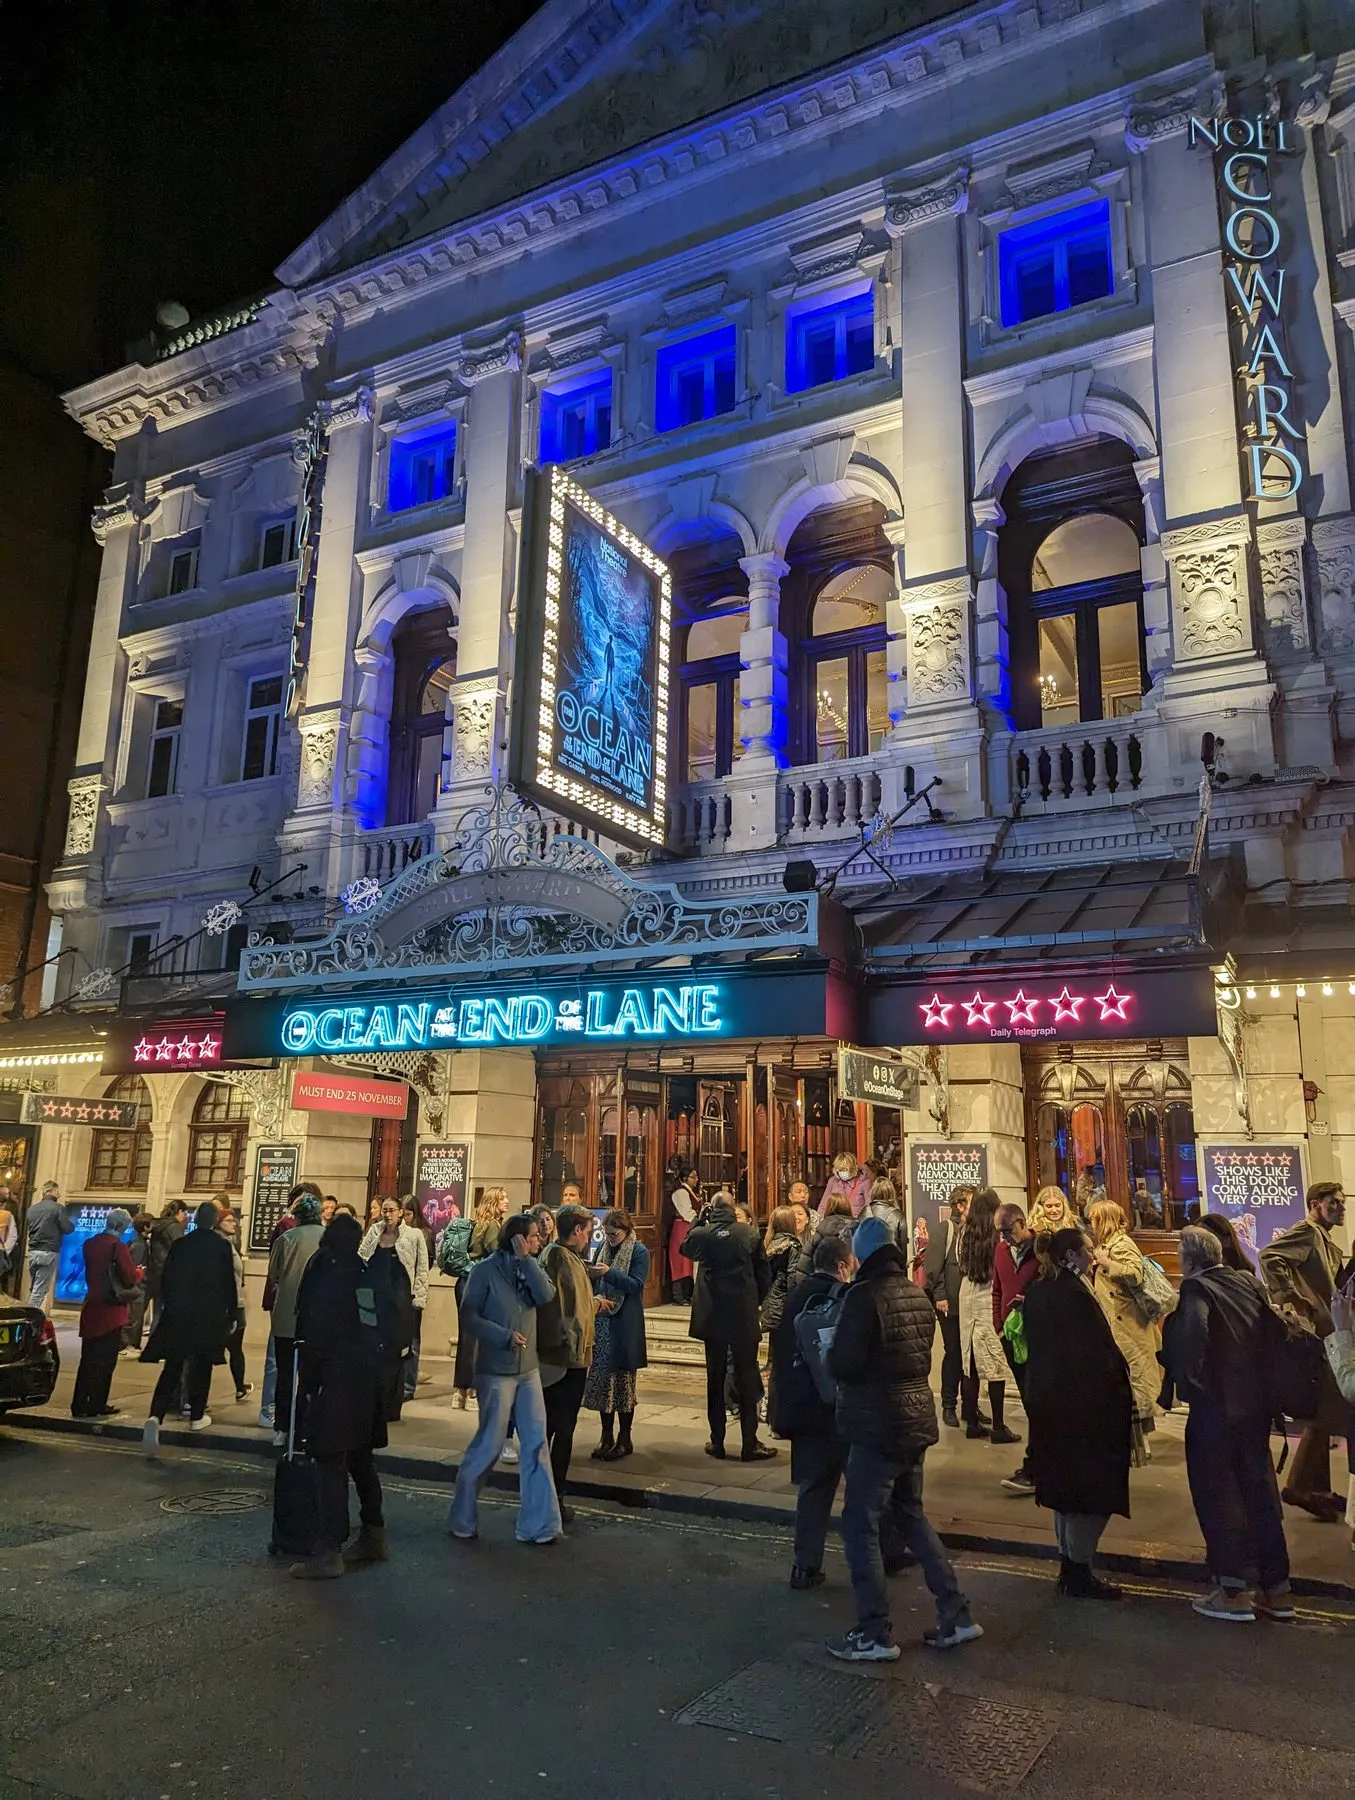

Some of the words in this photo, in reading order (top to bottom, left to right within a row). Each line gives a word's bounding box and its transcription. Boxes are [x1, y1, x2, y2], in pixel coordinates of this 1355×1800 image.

[1223, 153, 1306, 500] COWARD
[600, 536, 628, 568] National
[600, 547, 628, 578] Theatre
[556, 691, 652, 780] OCEAN
[573, 737, 603, 770] END
[602, 763, 612, 775] THE
[611, 759, 646, 796] LANE
[281, 1003, 430, 1051] OCEAN
[457, 995, 553, 1042] END
[584, 985, 723, 1036] LANE
[990, 1028, 1012, 1038] Daily
[1013, 1027, 1057, 1037] Telegraph
[299, 1085, 325, 1098] MUST
[326, 1088, 345, 1100] END
[345, 1090, 357, 1101] 25
[358, 1092, 403, 1106] NOVEMBER
[863, 1080, 904, 1100] @OceanOnStage
[421, 1166, 464, 1174] THRILLINGLY
[917, 1170, 982, 1180] MEMORABLE.
[1265, 1166, 1291, 1177] LIKE
[419, 1173, 464, 1182] IMAGINATIVE
[1219, 1175, 1247, 1185] THIS
[1249, 1176, 1288, 1186] DON'T
[929, 1191, 944, 1201] ITS
[1212, 1185, 1249, 1195] COME
[1252, 1186, 1298, 1196] ALONG
[1217, 1194, 1247, 1205] VERY
